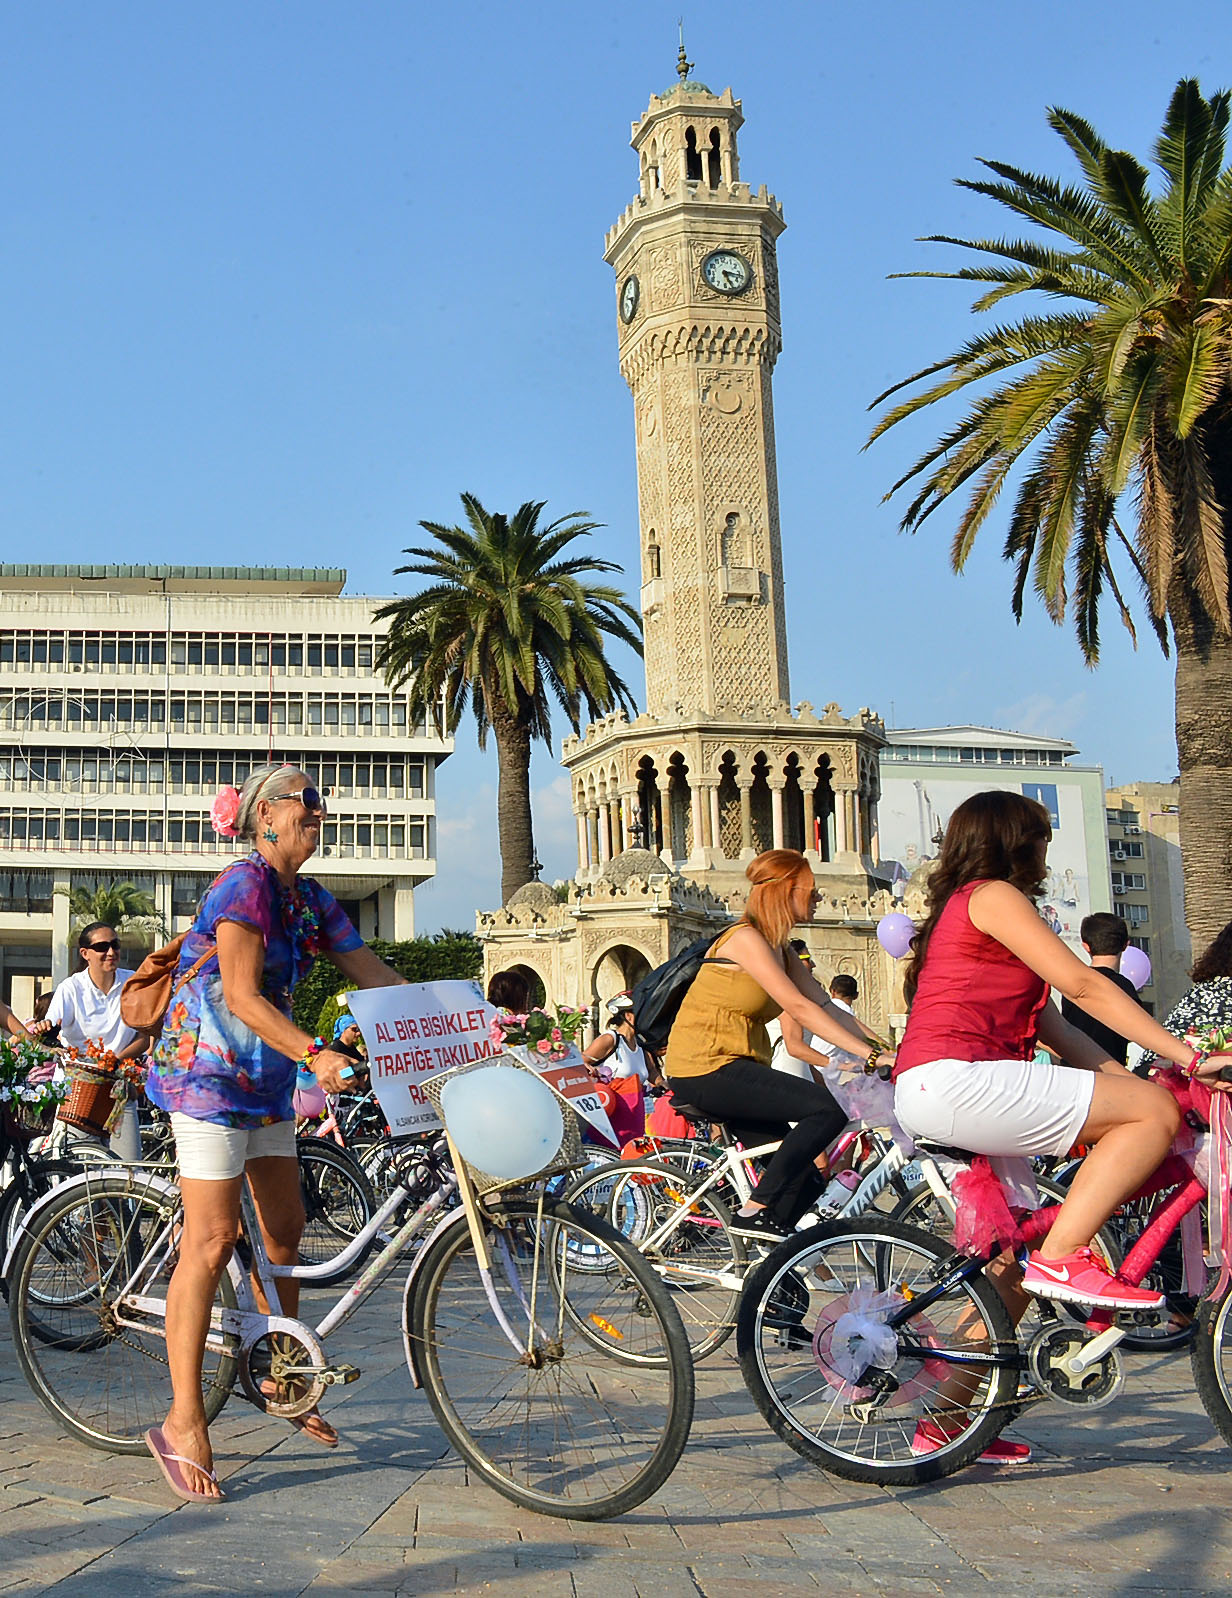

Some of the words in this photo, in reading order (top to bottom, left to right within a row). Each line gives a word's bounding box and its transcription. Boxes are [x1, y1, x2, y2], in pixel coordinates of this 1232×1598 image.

[375, 1022, 396, 1044] AL
[394, 1015, 421, 1041] BİR
[419, 1009, 487, 1039] BİSİKLET
[374, 1045, 435, 1078] TRAFİĞE
[575, 1096, 601, 1113] 182
